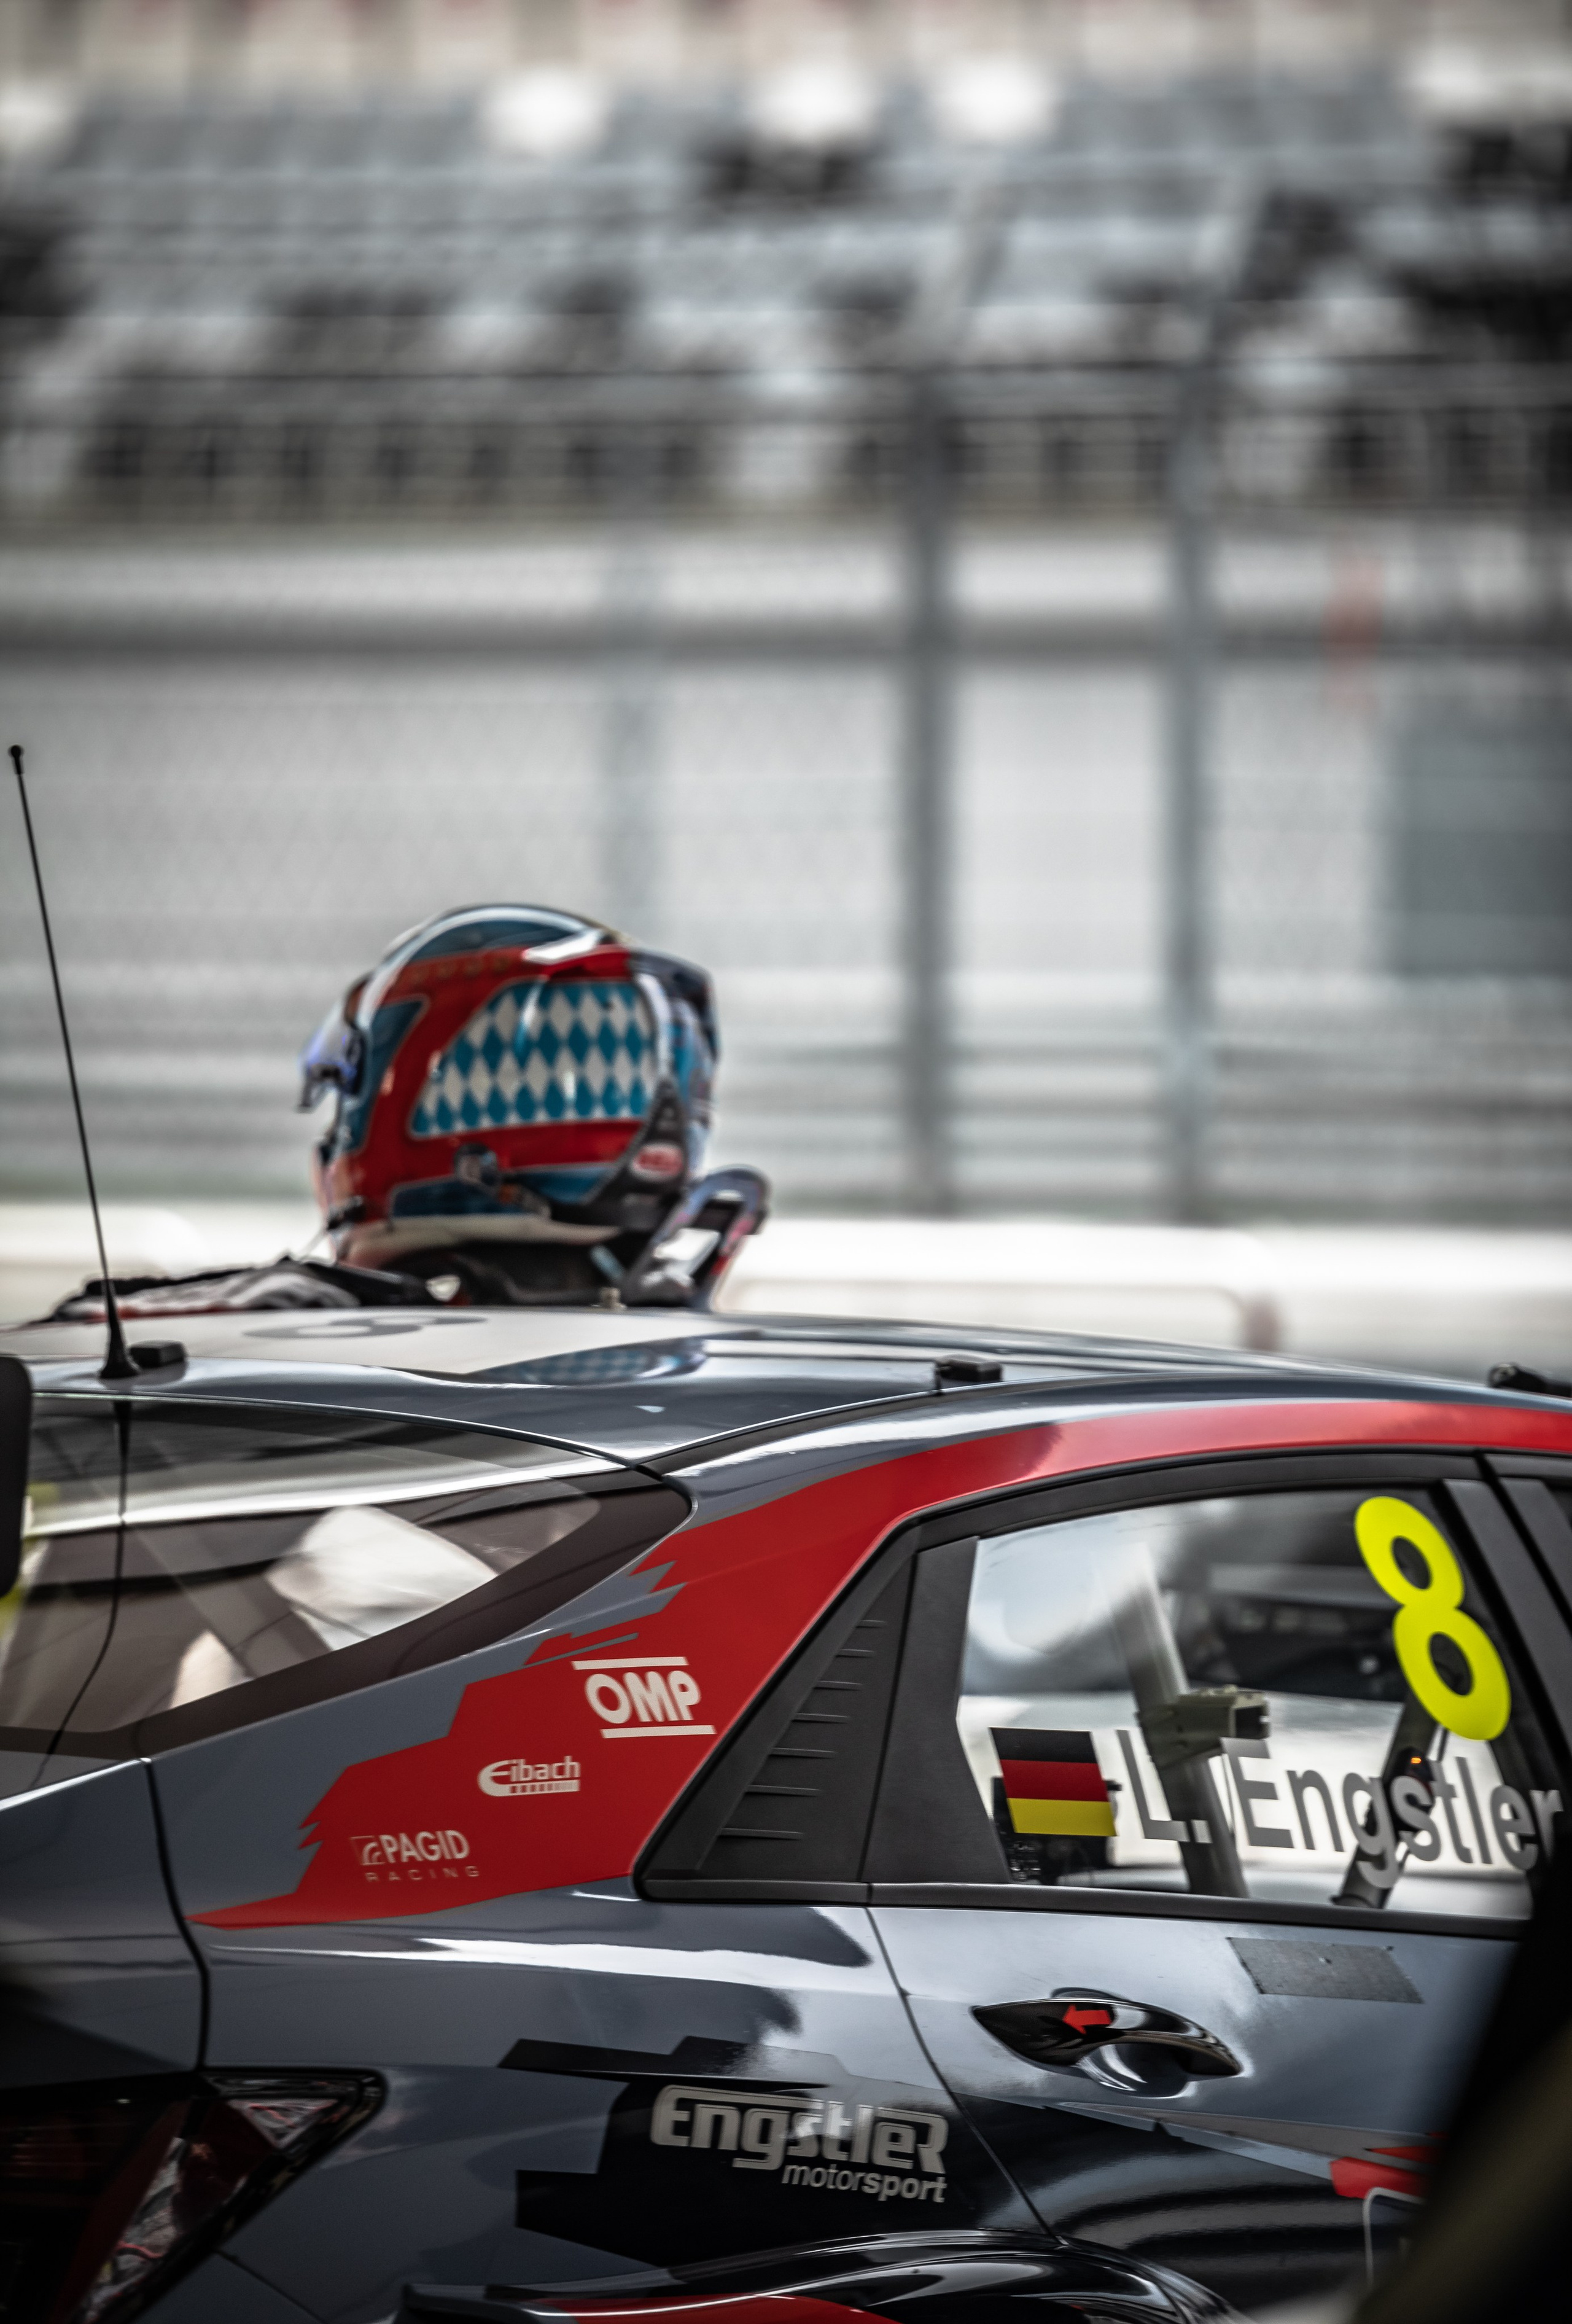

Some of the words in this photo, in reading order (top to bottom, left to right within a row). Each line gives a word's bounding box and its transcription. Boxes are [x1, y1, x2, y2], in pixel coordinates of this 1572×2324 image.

[1355, 1496, 1511, 1741] 8
[585, 1671, 701, 1724] OMP
[478, 1755, 581, 1797] Eibach
[1116, 1729, 1212, 1843] L.
[1223, 1737, 1564, 1889] Engstler
[379, 1830, 470, 1863] PAGID
[365, 1865, 480, 1882] RACING
[782, 2162, 947, 2203] motorsport
